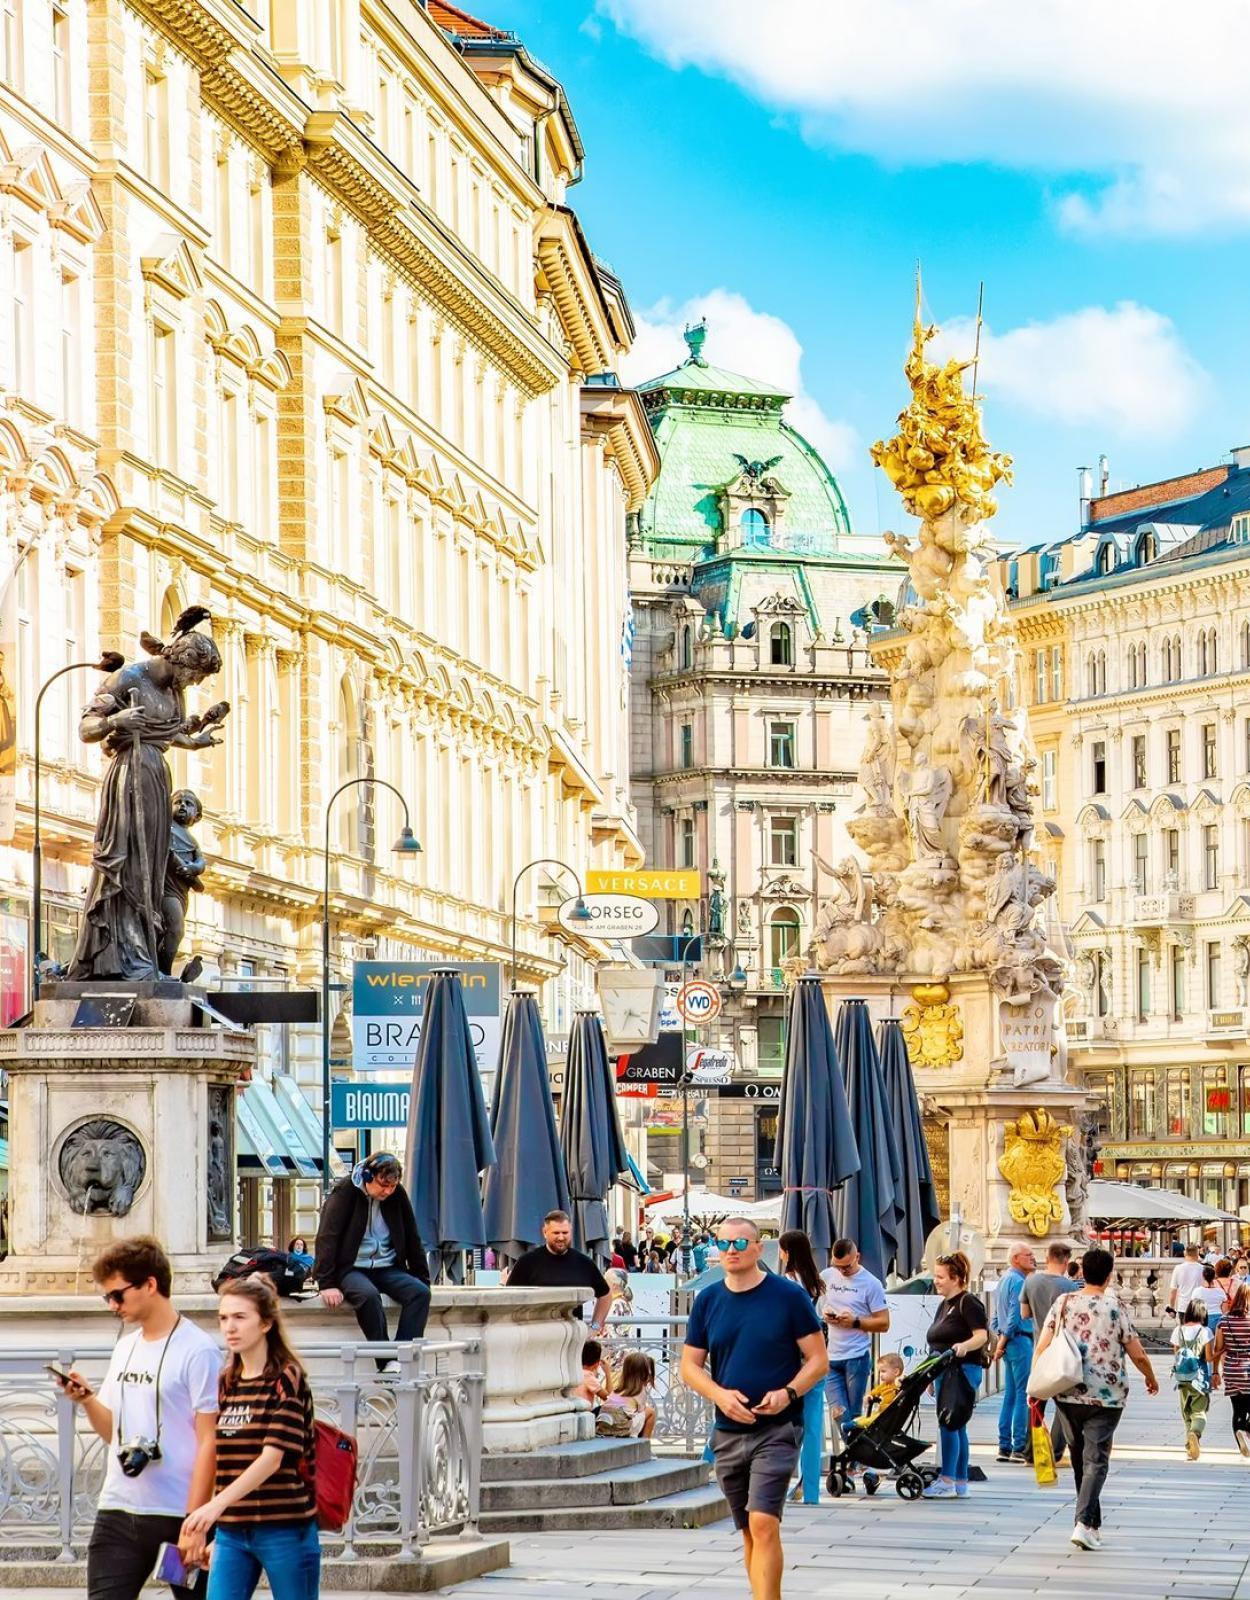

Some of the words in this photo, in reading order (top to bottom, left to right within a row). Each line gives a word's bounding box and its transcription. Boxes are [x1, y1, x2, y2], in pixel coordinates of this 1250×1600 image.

[598, 877, 688, 892] VERSACE
[586, 906, 644, 919] ORSEG
[367, 972, 487, 988] wienin
[1005, 1024, 1047, 1036] PATRI
[626, 1067, 675, 1078] GRABEN
[615, 1084, 648, 1094] CAMPER
